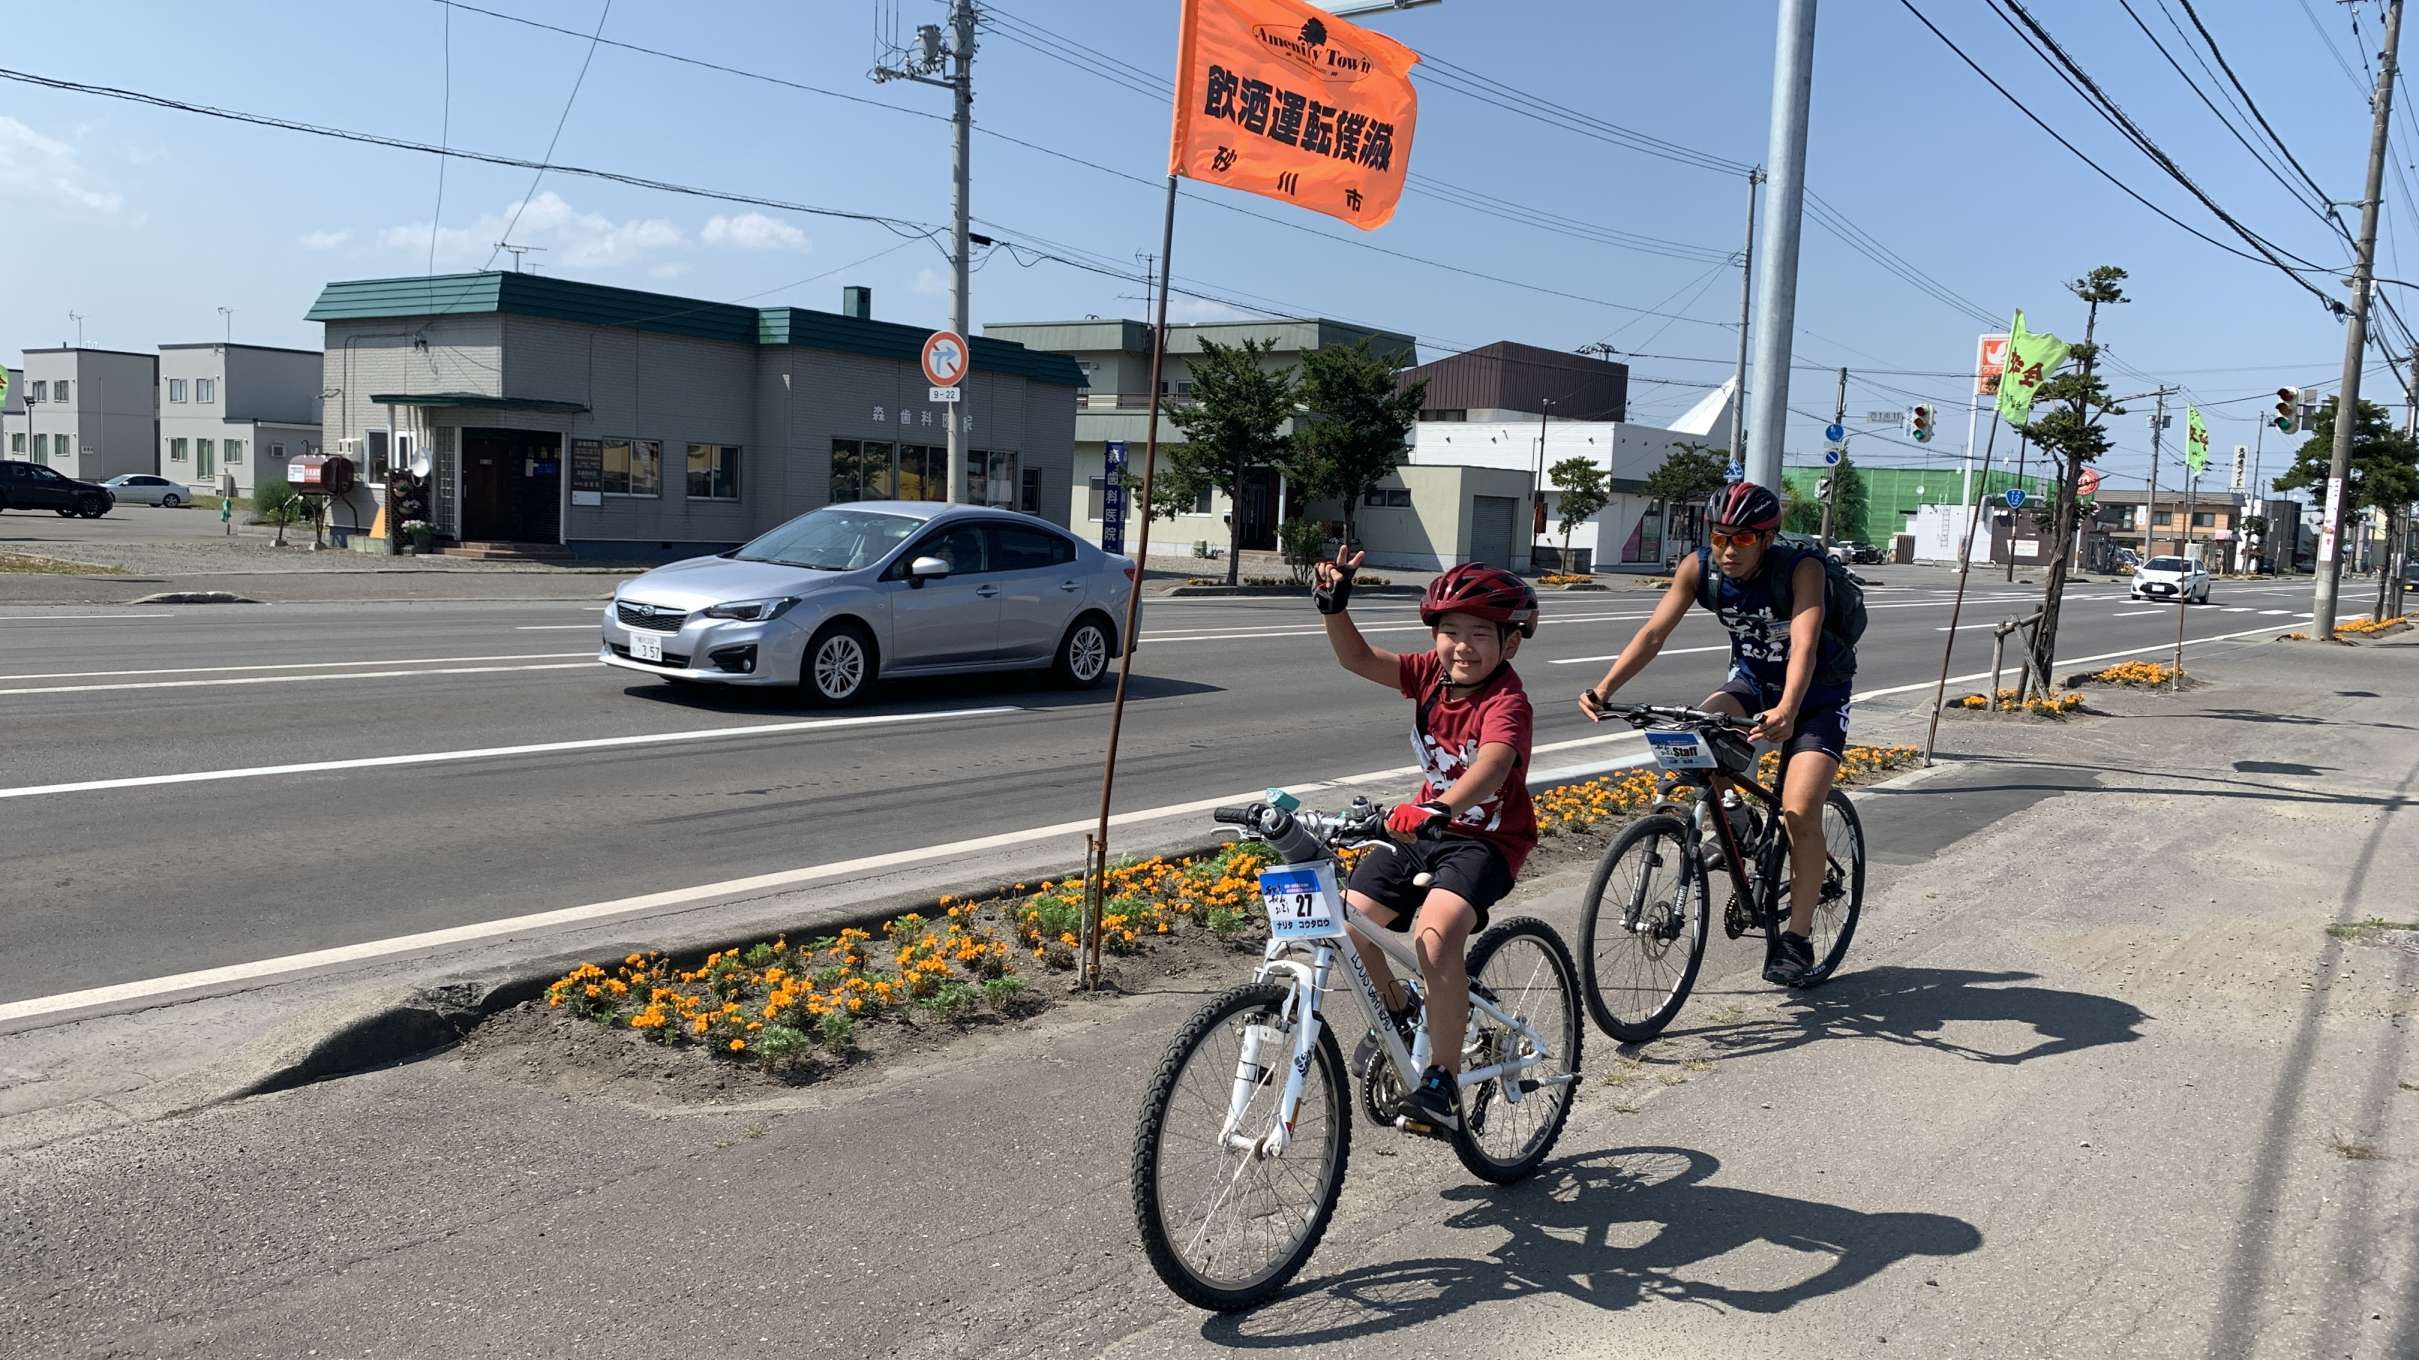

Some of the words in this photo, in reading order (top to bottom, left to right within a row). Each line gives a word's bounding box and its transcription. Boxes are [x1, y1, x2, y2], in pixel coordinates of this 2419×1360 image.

[1254, 27, 1321, 63] Amenity
[1326, 49, 1371, 74] Town
[1204, 64, 1394, 173] 飲酒運転撲滅
[933, 390, 955, 399] 9-22
[1104, 448, 1119, 542] 森歯科医院
[2011, 494, 2020, 502] 12
[1672, 746, 1697, 757] Staff
[1295, 893, 1313, 918] 27
[1276, 921, 1293, 930] ナリタ
[1299, 919, 1330, 929] コウタロウ
[1351, 953, 1370, 986] LOUIS
